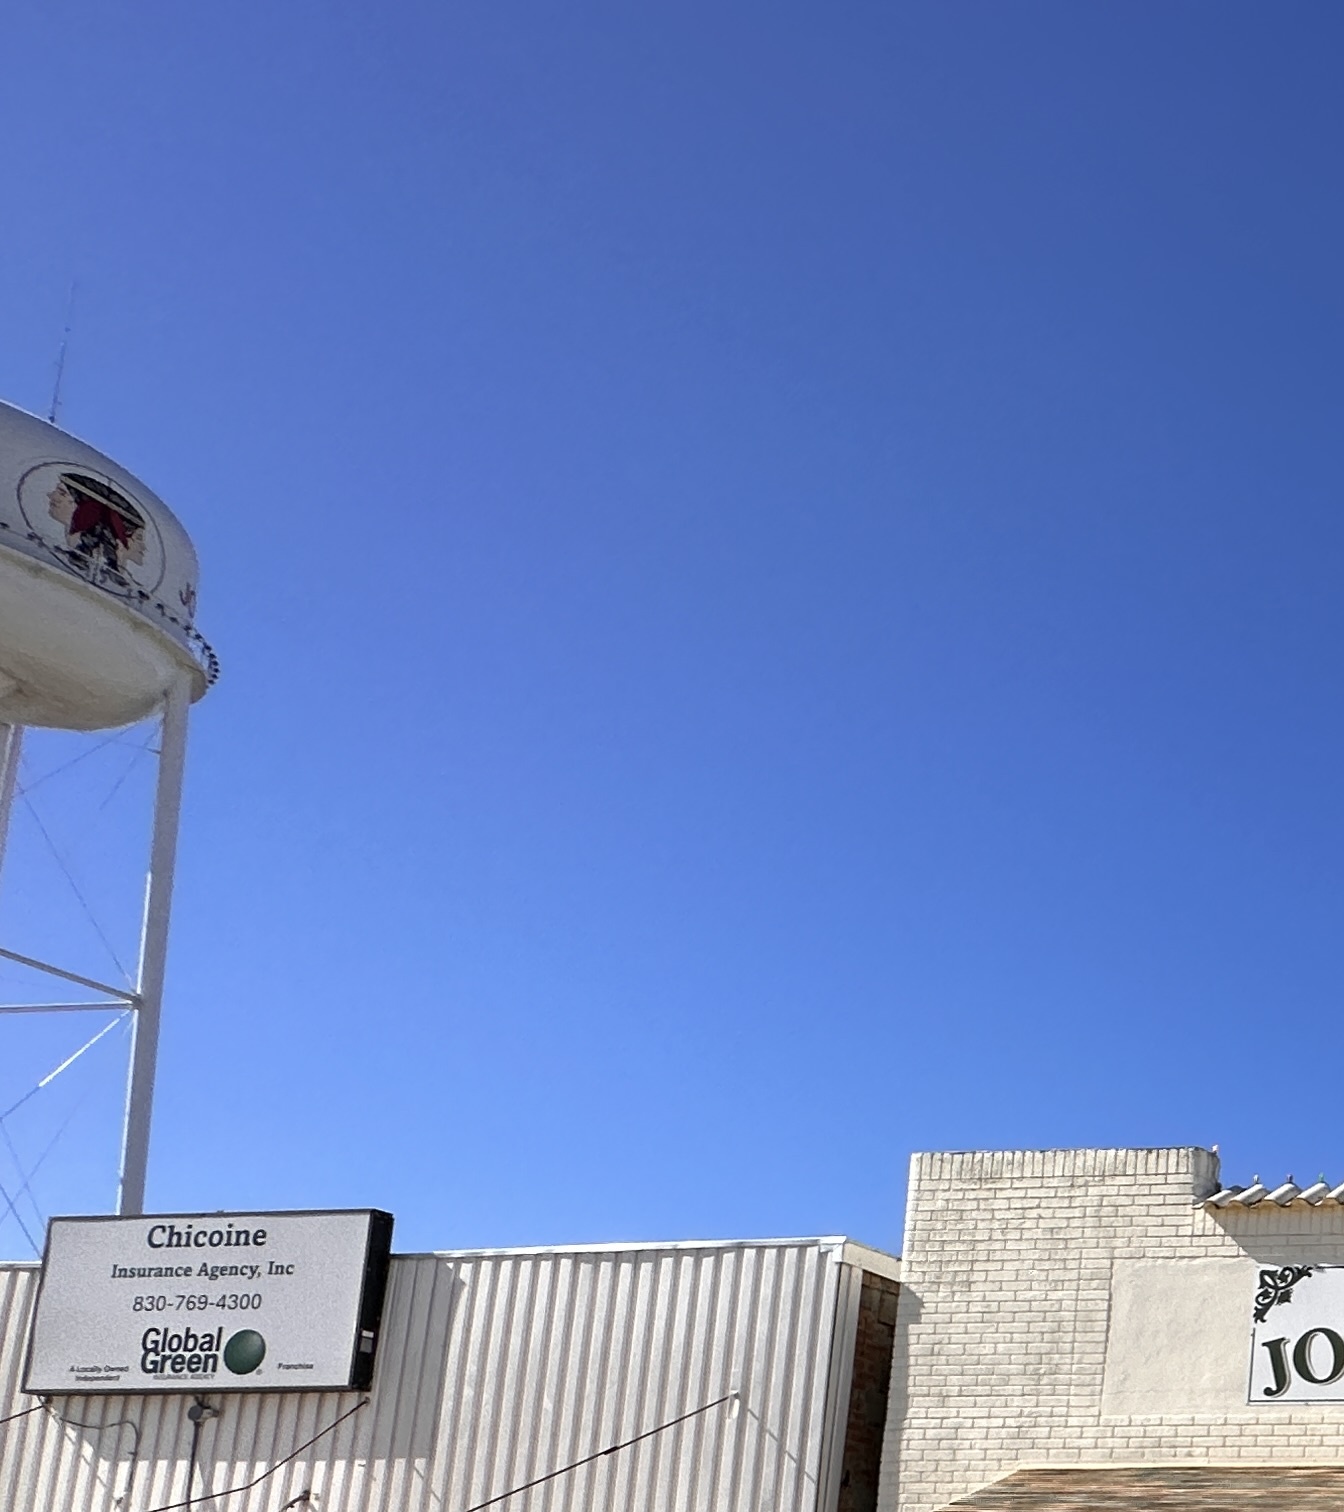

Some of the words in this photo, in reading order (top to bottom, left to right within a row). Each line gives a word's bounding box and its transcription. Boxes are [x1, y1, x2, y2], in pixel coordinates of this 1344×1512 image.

[147, 1223, 267, 1248] Chicoine
[111, 1263, 192, 1279] Insurance
[196, 1262, 262, 1280] Agency,
[267, 1261, 294, 1276] Inc
[132, 1293, 262, 1312] 830-769-4300
[141, 1326, 223, 1353] Global
[140, 1349, 218, 1374] Green
